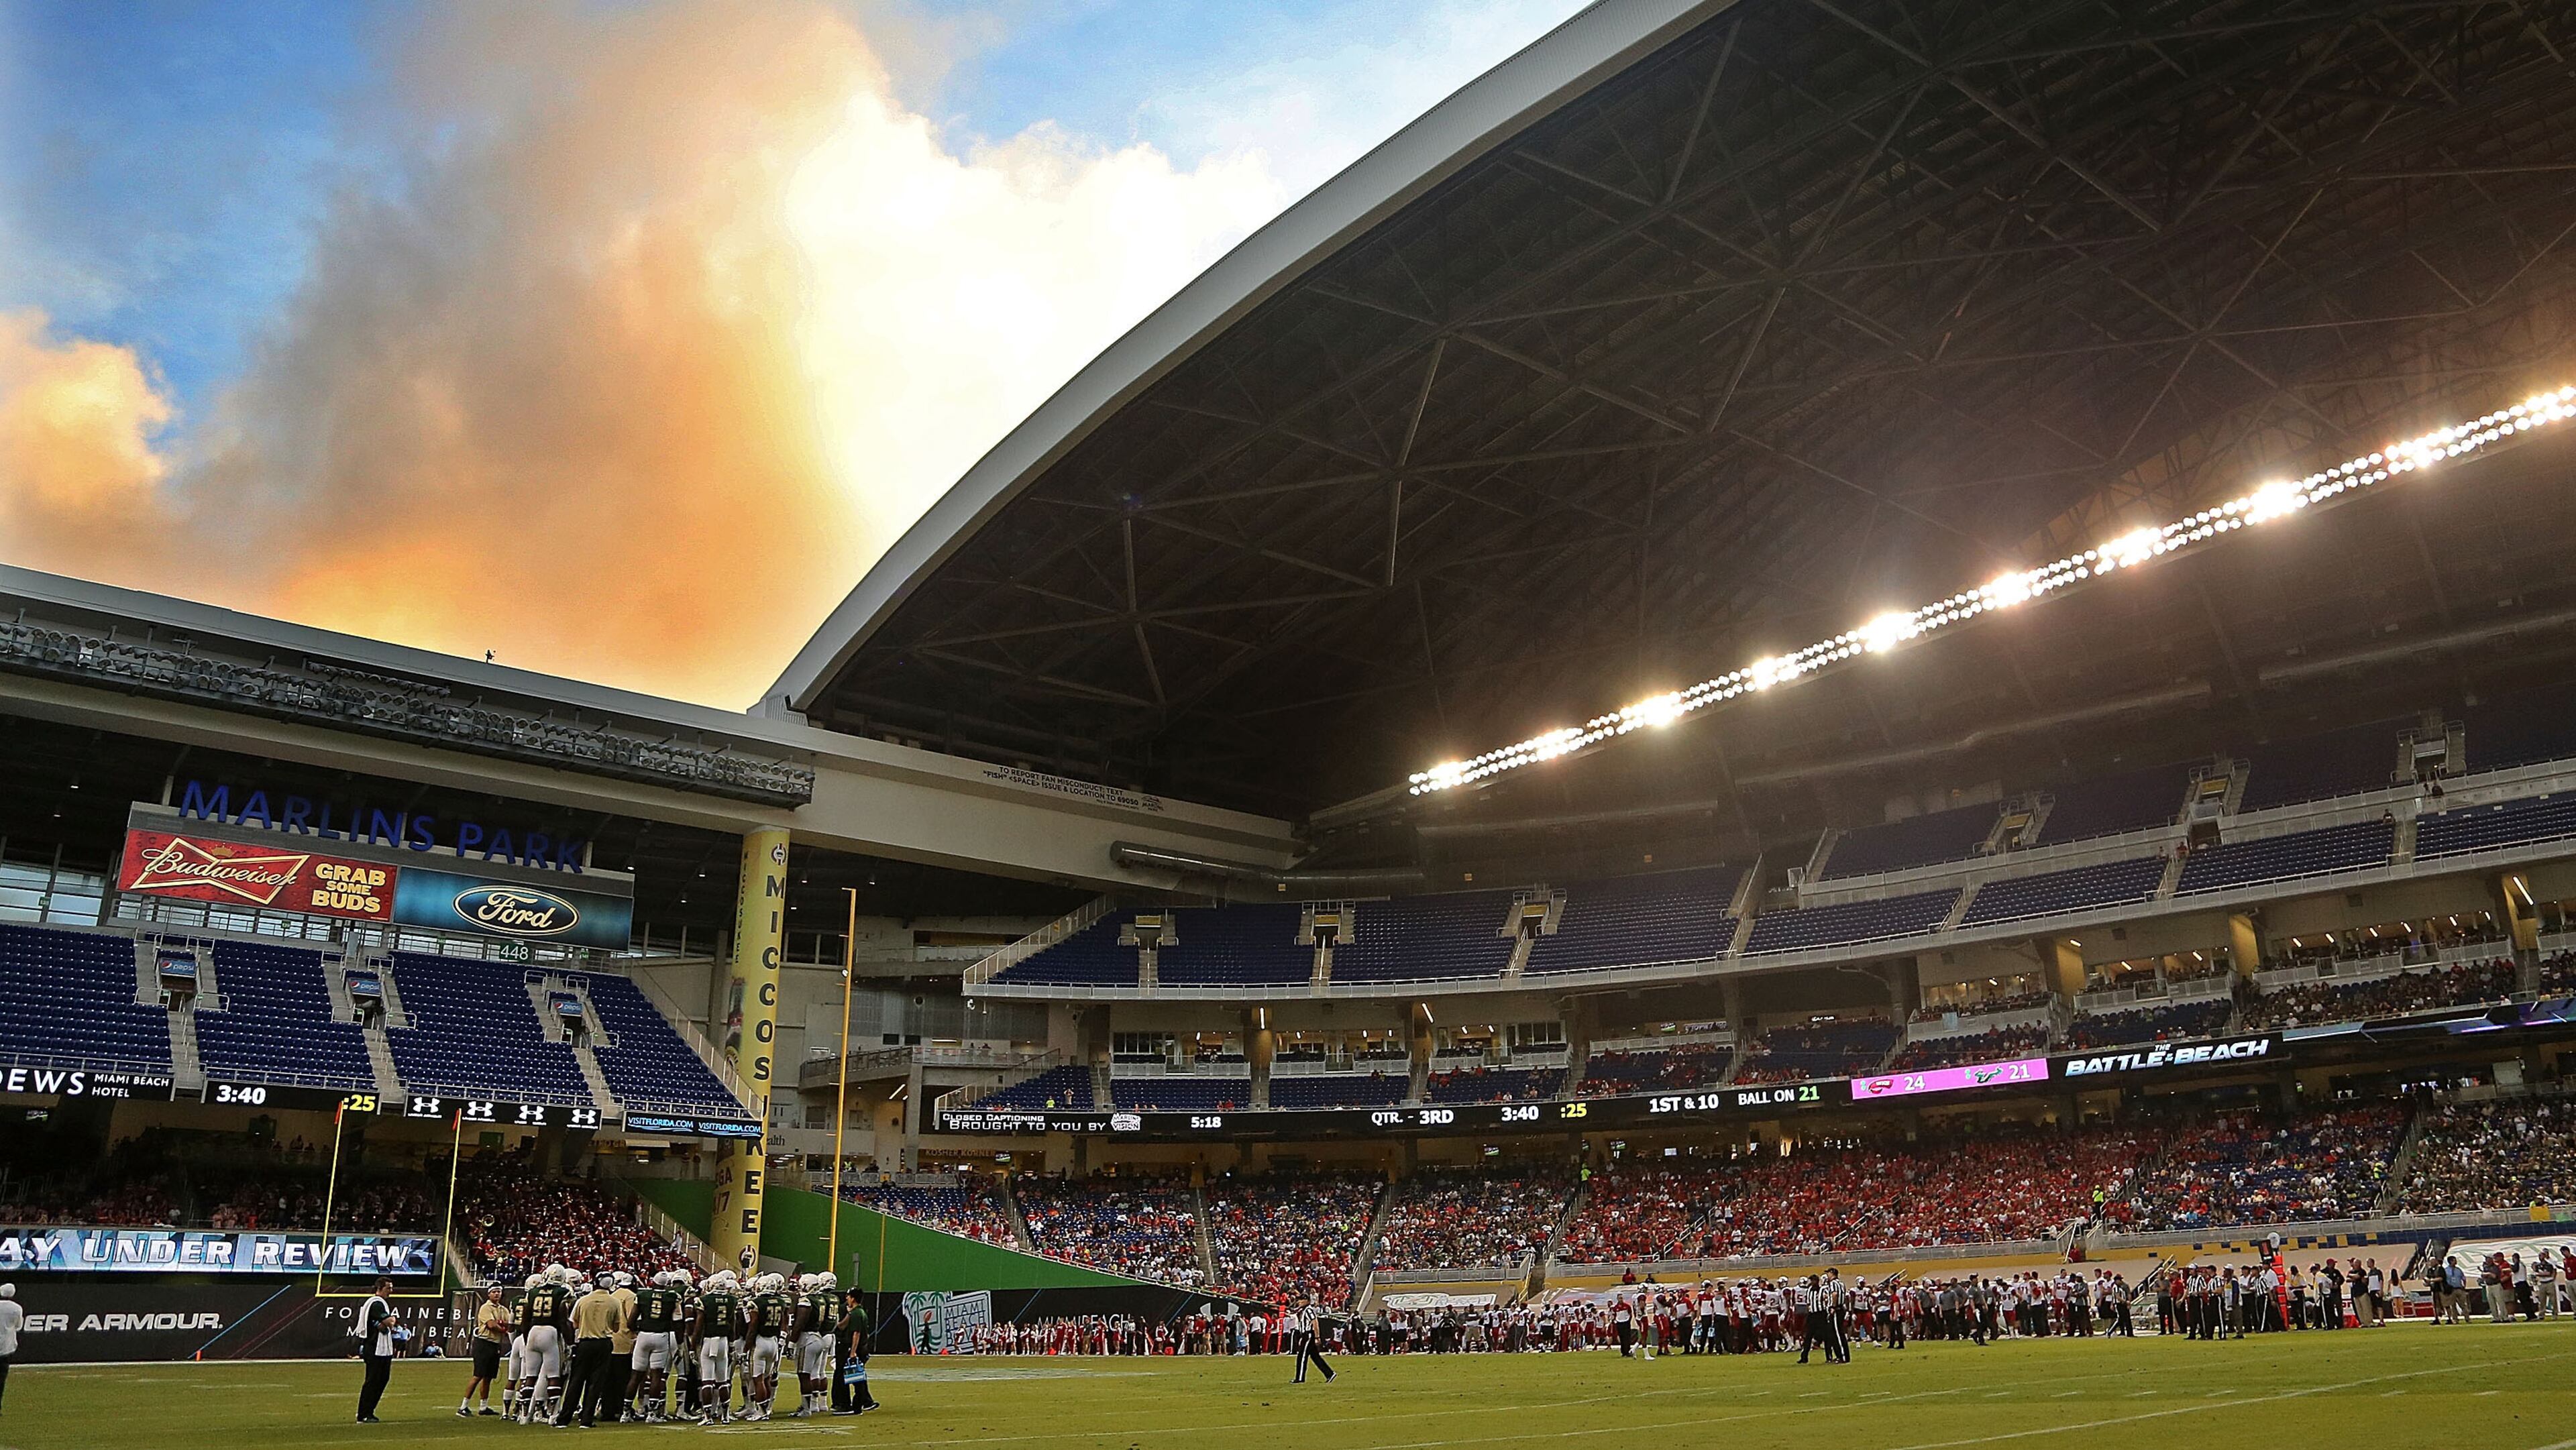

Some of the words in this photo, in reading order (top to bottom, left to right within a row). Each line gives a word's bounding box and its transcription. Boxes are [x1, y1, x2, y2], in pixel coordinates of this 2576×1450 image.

[1011, 769, 1040, 779] REPORT
[1042, 775, 1055, 783] FAN
[1106, 787, 1123, 795] TEXT
[1041, 782, 1062, 791] ISSUE
[1070, 787, 1105, 799] LOCATION
[1117, 796, 1139, 805] 69050
[178, 780, 436, 852] MARLINS
[456, 822, 587, 874] PARK
[141, 848, 297, 886] Budweiser
[315, 863, 386, 887] GRAB
[325, 880, 372, 897] SOME
[311, 890, 381, 913] BUDS
[478, 891, 557, 929] Ford
[500, 944, 529, 961] 448
[172, 963, 194, 971] pepsi
[741, 874, 786, 1234] MICCOSKEE
[2154, 1044, 2171, 1052] THE
[2065, 1050, 2166, 1076] BATTLE
[2174, 1039, 2269, 1065] BEACH
[94, 1073, 130, 1084] MIAMI
[133, 1075, 170, 1087] BEACH
[2007, 1064, 2031, 1080] 21
[0, 1068, 85, 1095] EWS
[1904, 1075, 1926, 1091] 24
[91, 1086, 130, 1098] HOTEL
[216, 1084, 267, 1105] 3:40
[1737, 1091, 1771, 1105] BALL
[1774, 1089, 1795, 1103] ON
[1799, 1086, 1820, 1102] 21
[342, 1095, 376, 1112] :25
[1560, 1103, 1588, 1119] :25
[1649, 1097, 1681, 1113] 1ST
[1684, 1097, 1696, 1110] &
[1698, 1094, 1719, 1110] 10
[1371, 1113, 1403, 1126] QTR.
[1419, 1109, 1454, 1125] 3RD
[1501, 1105, 1540, 1122] 3:40
[628, 1117, 694, 1129] VISITFLORIDA.COM
[698, 1121, 761, 1133] VISITFLORIDA.COM
[950, 1121, 1022, 1130] BROUGHT
[1027, 1122, 1045, 1131] TO
[1052, 1123, 1081, 1131] YOU
[1089, 1123, 1106, 1131] BY
[1191, 1116, 1222, 1129] 5:18
[82, 1238, 233, 1264] UNDER
[252, 1241, 409, 1268] REVIEW
[533, 1296, 553, 1317] 93
[945, 1301, 985, 1318] MIAMI
[945, 1310, 985, 1331] BEACH
